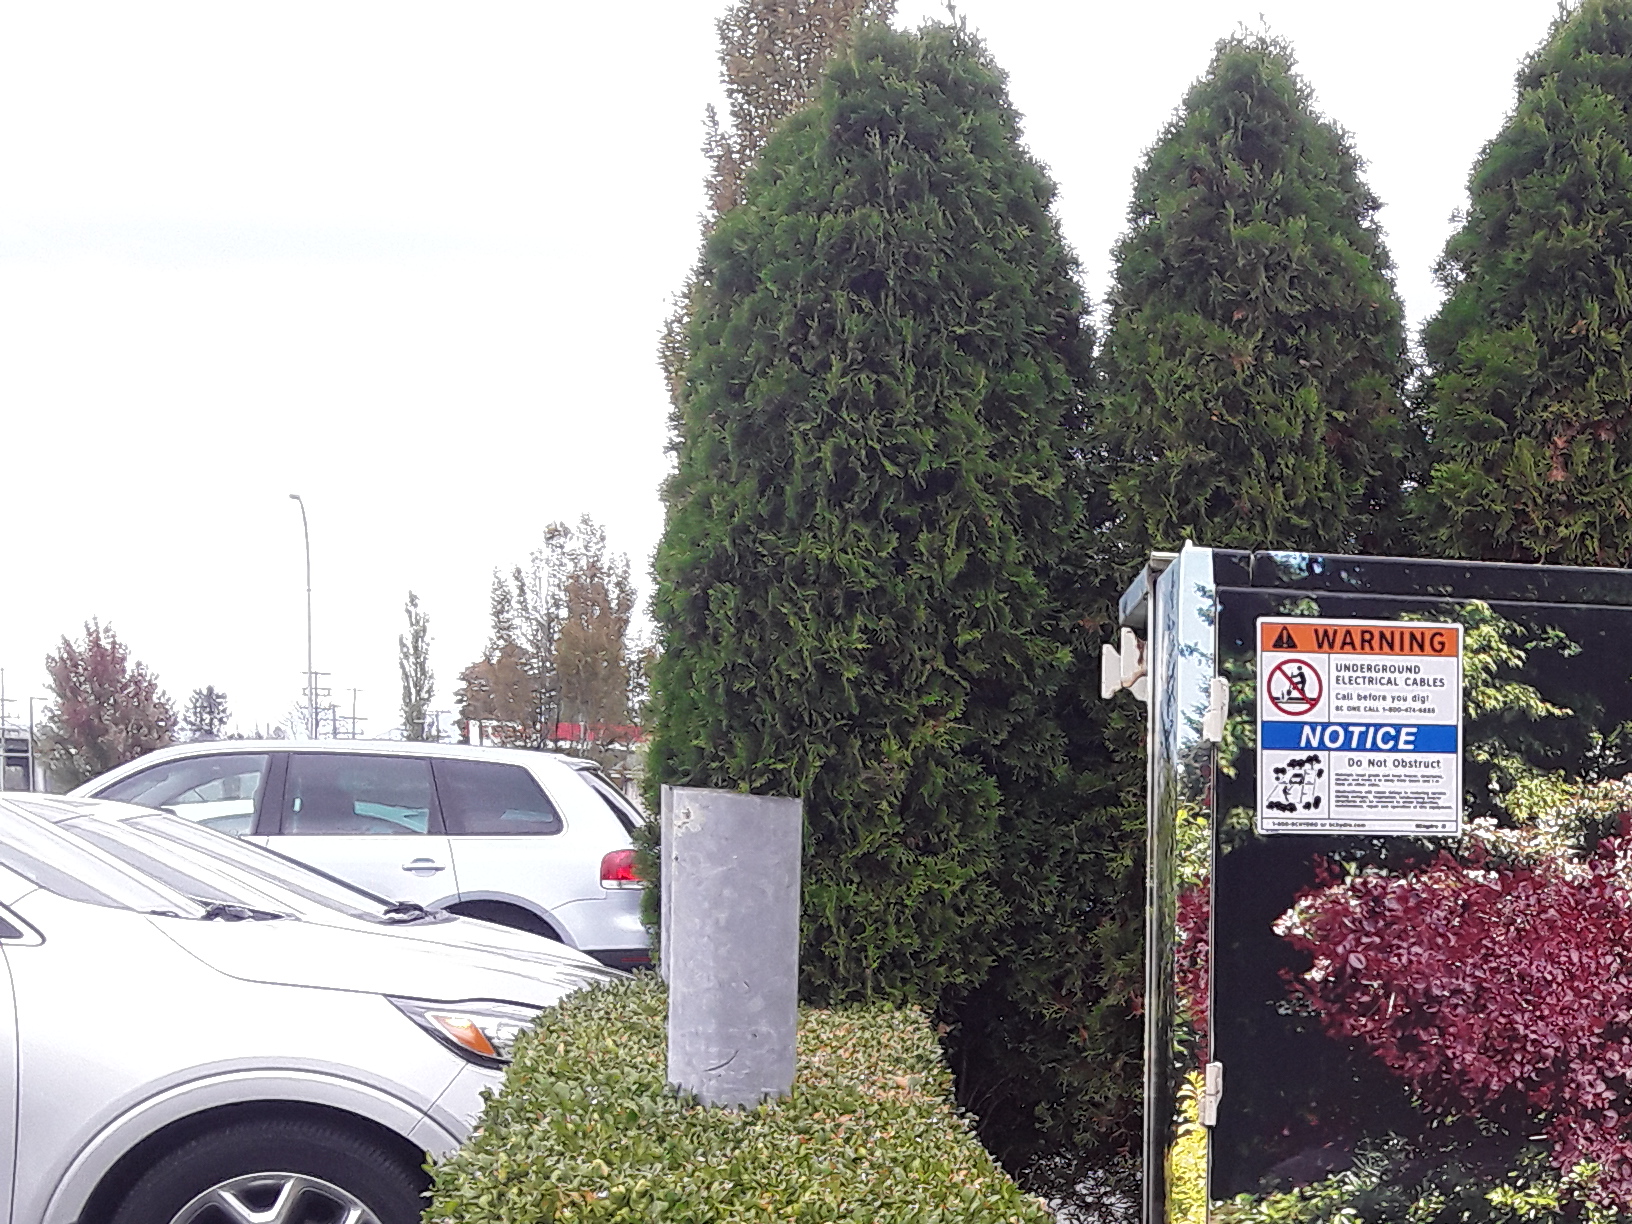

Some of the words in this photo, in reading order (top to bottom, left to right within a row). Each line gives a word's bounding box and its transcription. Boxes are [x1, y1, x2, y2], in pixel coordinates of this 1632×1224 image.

[1313, 627, 1446, 653] WARNING
[1335, 663, 1421, 674] UNDERGROUND
[1335, 675, 1399, 686] ELECTRICAL
[1404, 677, 1445, 687] CABLES
[1335, 692, 1353, 701] Call
[1357, 692, 1387, 702] before
[1391, 695, 1407, 704] you
[1299, 725, 1418, 750] NOTICE
[1347, 758, 1363, 768] Do
[1368, 758, 1387, 768] Not
[1392, 758, 1441, 769] Obstruct
